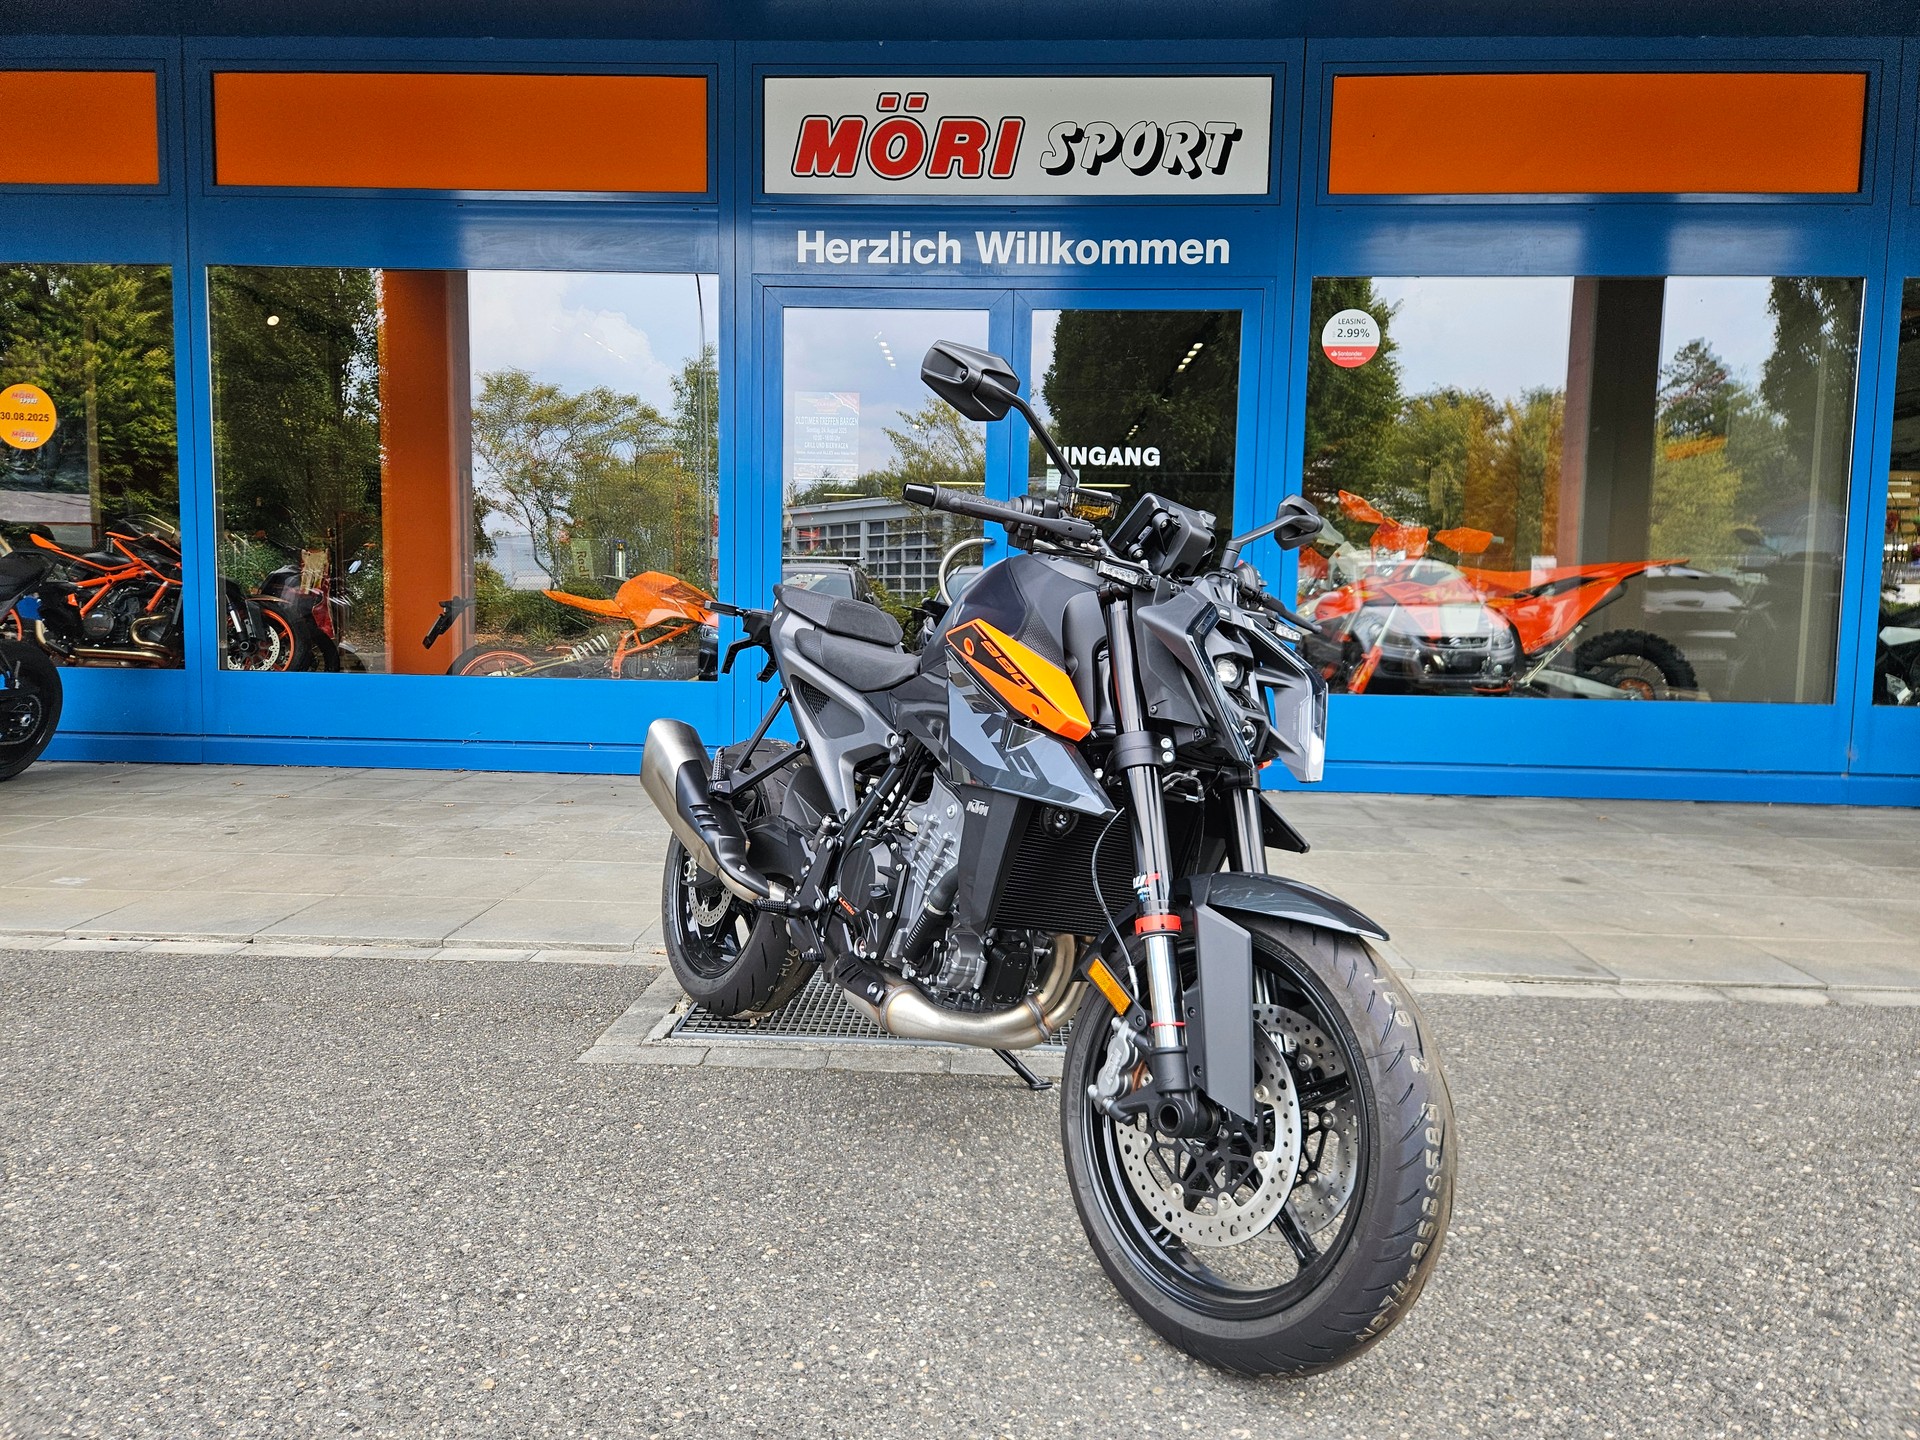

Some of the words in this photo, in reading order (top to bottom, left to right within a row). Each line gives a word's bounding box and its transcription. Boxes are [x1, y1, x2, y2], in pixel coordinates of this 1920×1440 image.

[791, 92, 1025, 180] MÖRI
[1039, 120, 1244, 179] SPORT
[798, 230, 961, 264] Herzlich
[975, 230, 1230, 264] Willkommen
[1337, 328, 1370, 338] 2.99%
[0, 411, 50, 422] 30.08.2025
[980, 640, 1035, 692] 990
[965, 799, 990, 817] KTM
